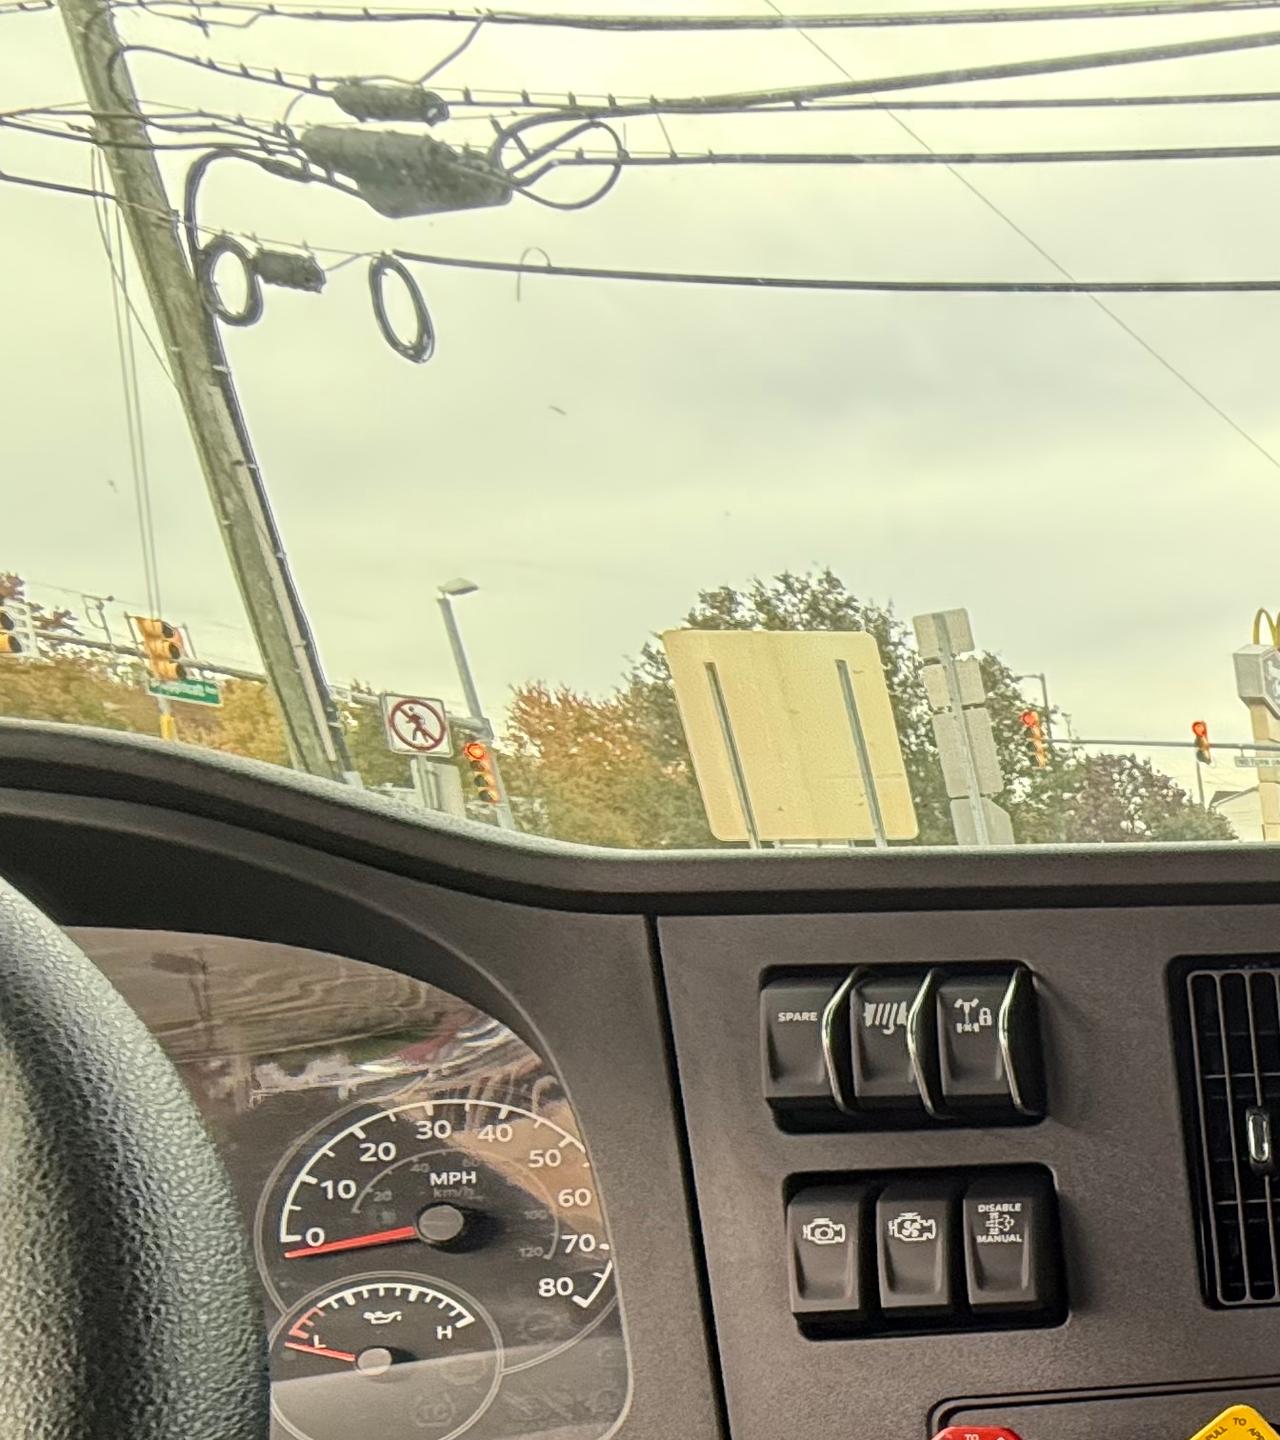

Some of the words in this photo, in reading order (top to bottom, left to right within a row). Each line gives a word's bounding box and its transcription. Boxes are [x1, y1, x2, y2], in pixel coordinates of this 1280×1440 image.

[778, 1011, 818, 1023] SPARE
[416, 1119, 452, 1140] 30
[478, 1124, 513, 1143] 40
[359, 1142, 396, 1162] 20
[528, 1149, 561, 1168] 50
[429, 1171, 477, 1186] MPH
[320, 1180, 356, 1200] 10
[558, 1189, 591, 1207] 60
[978, 1203, 1022, 1213] DISABLE
[305, 1227, 325, 1246] 0
[561, 1234, 596, 1252] 70
[977, 1232, 1022, 1244] MANUAL
[538, 1277, 574, 1297] 80
[437, 1325, 452, 1339] H
[1233, 1417, 1246, 1425] TO
